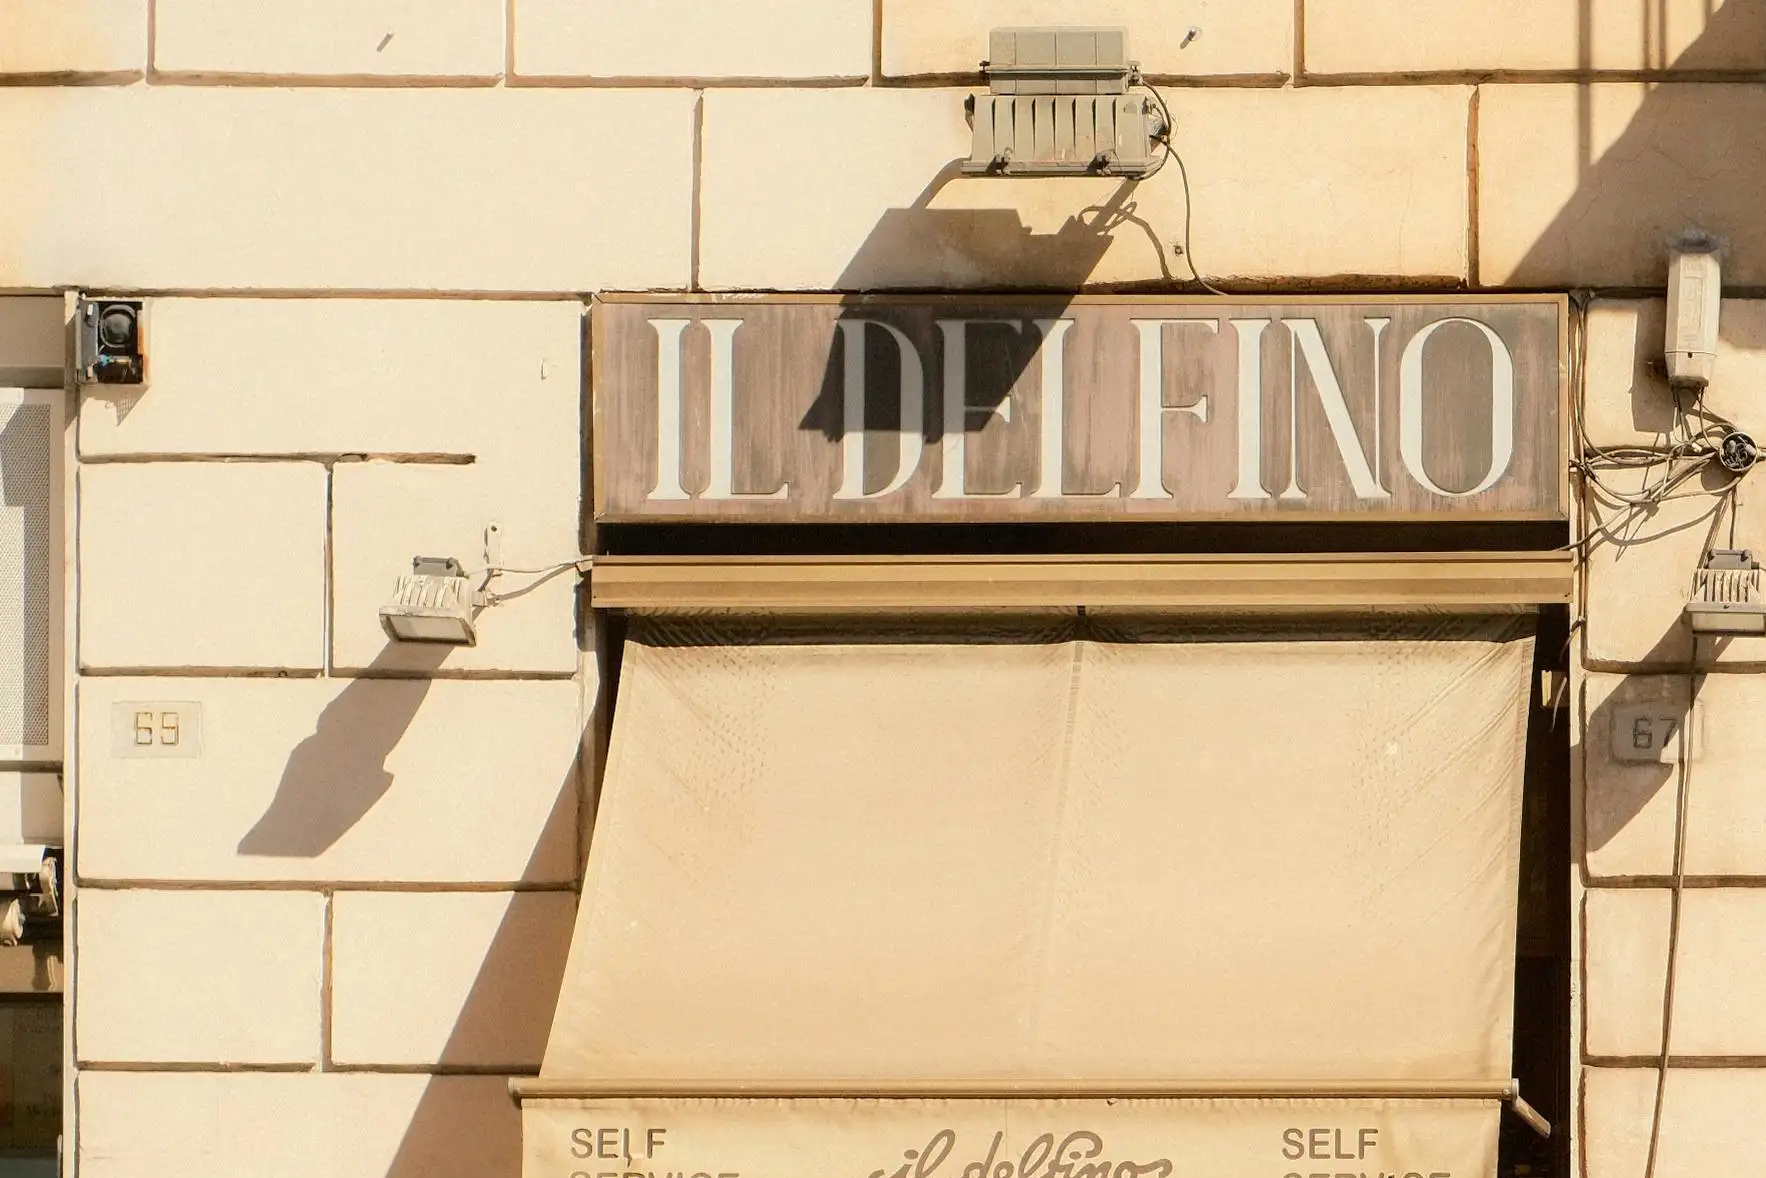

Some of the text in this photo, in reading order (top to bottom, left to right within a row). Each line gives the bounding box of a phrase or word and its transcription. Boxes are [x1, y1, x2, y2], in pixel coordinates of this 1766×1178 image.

[646, 316, 1513, 500] IL DELFINO
[570, 1128, 668, 1161] SELF
[1281, 1128, 1378, 1161] SELF
